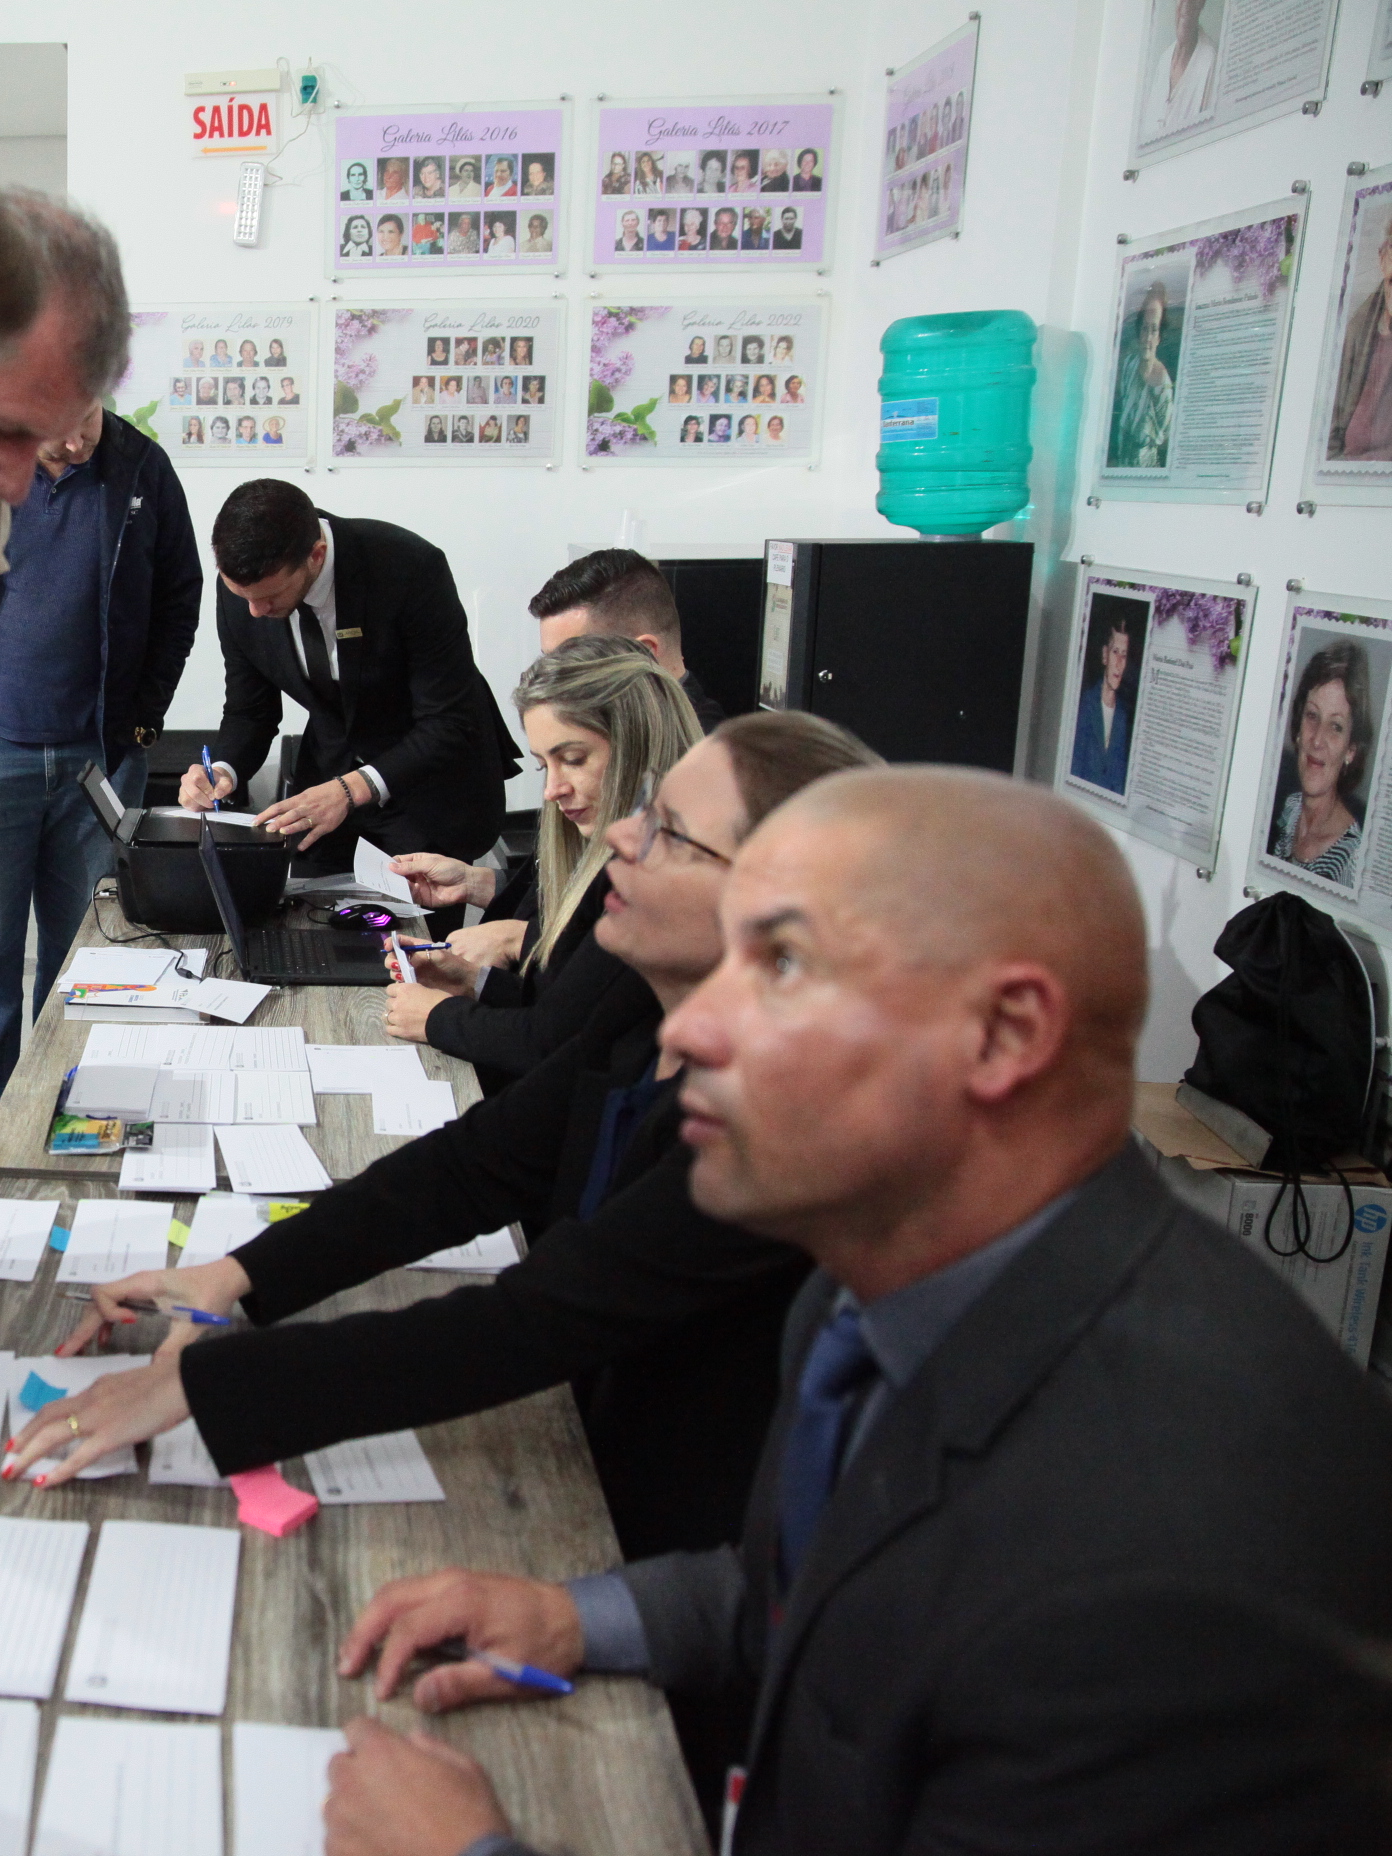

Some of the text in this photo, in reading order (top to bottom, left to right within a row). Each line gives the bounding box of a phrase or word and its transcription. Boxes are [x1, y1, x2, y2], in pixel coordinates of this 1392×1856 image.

[192, 96, 273, 140] SAÍDA
[380, 124, 433, 152] Galeria
[479, 126, 518, 141] 2016
[645, 116, 699, 146] Galeria
[747, 120, 790, 136] 2017
[264, 315, 294, 329] 2019
[506, 315, 541, 329] 2020
[767, 313, 803, 327] 2022
[1243, 1213, 1254, 1236] 8000
[1355, 1206, 1388, 1232] hp
[1361, 1242, 1373, 1257] Ink
[1357, 1262, 1371, 1284] Tank
[1348, 1289, 1367, 1332] Wireless
